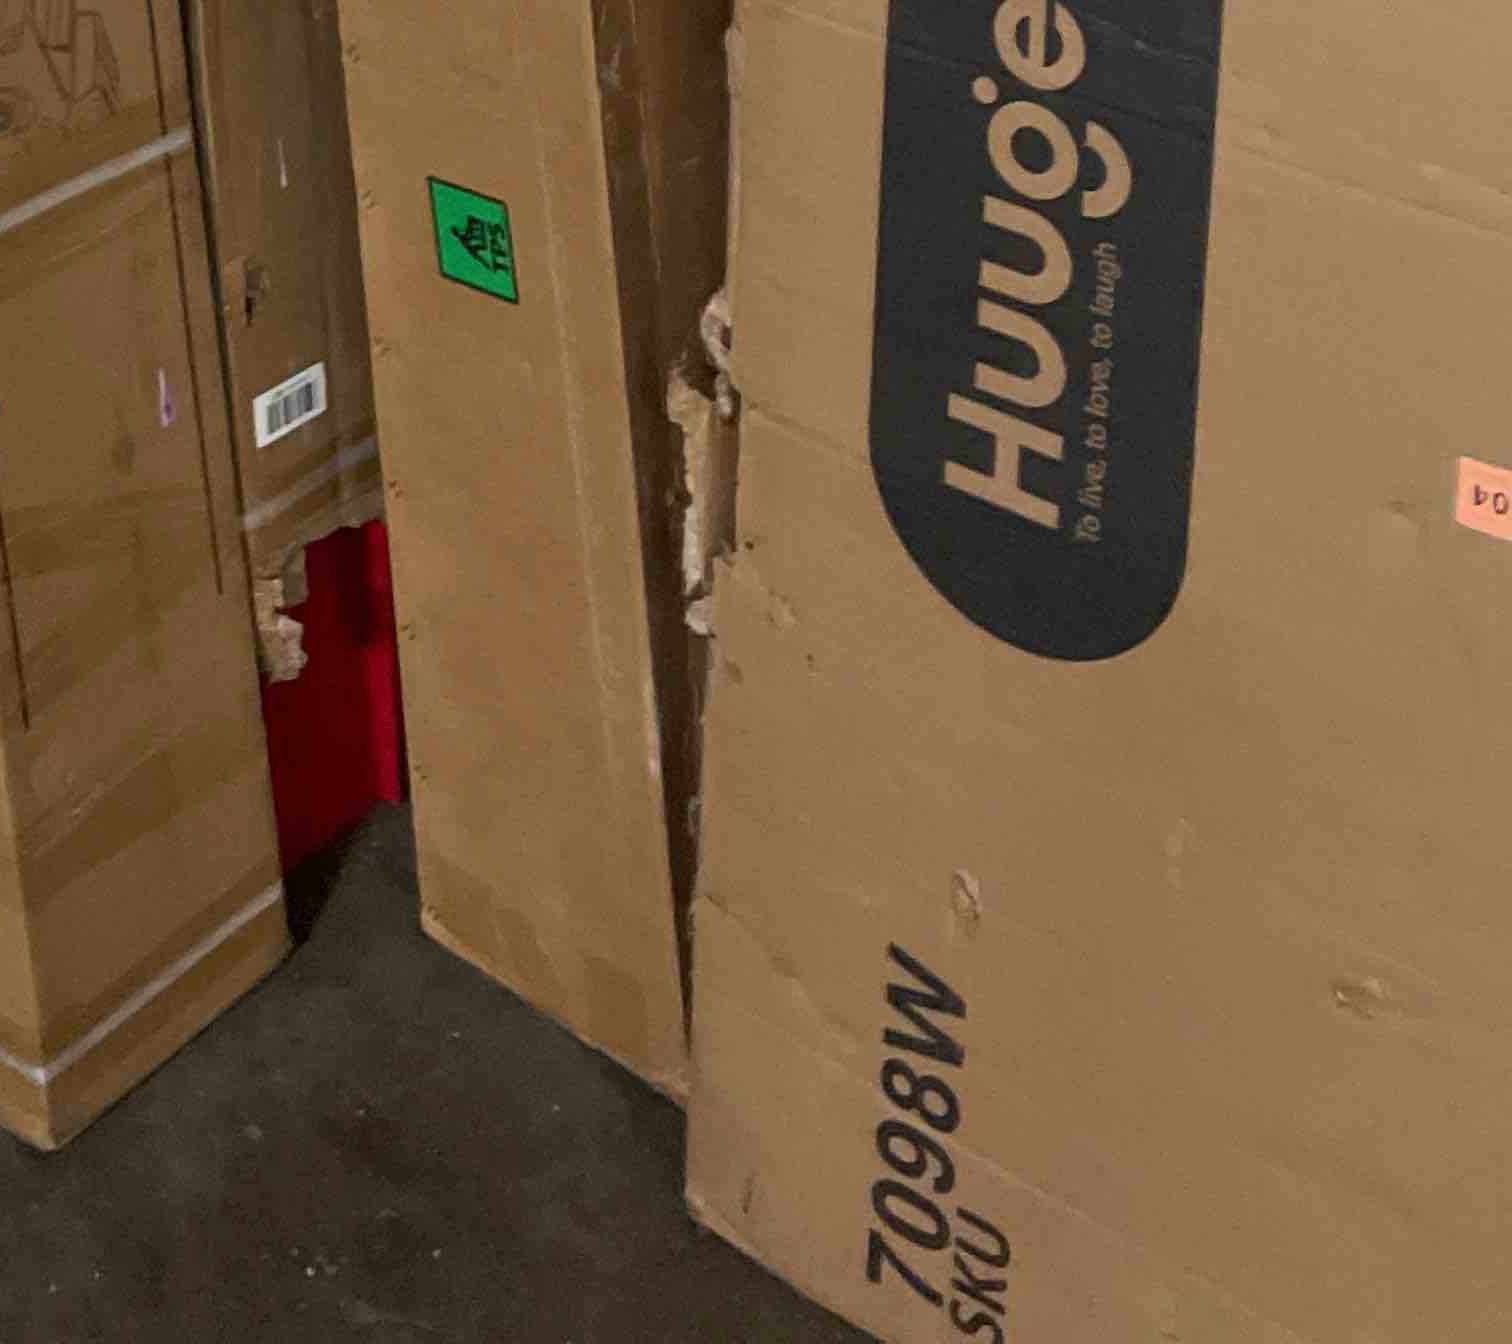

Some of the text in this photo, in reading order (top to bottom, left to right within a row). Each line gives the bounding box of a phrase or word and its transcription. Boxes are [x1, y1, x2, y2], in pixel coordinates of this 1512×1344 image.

[1089, 240, 1124, 317] laugh
[1090, 321, 1113, 350] to
[1085, 423, 1107, 450] to
[865, 942, 967, 1308] 7098W
[947, 1208, 1010, 1344] SKU
